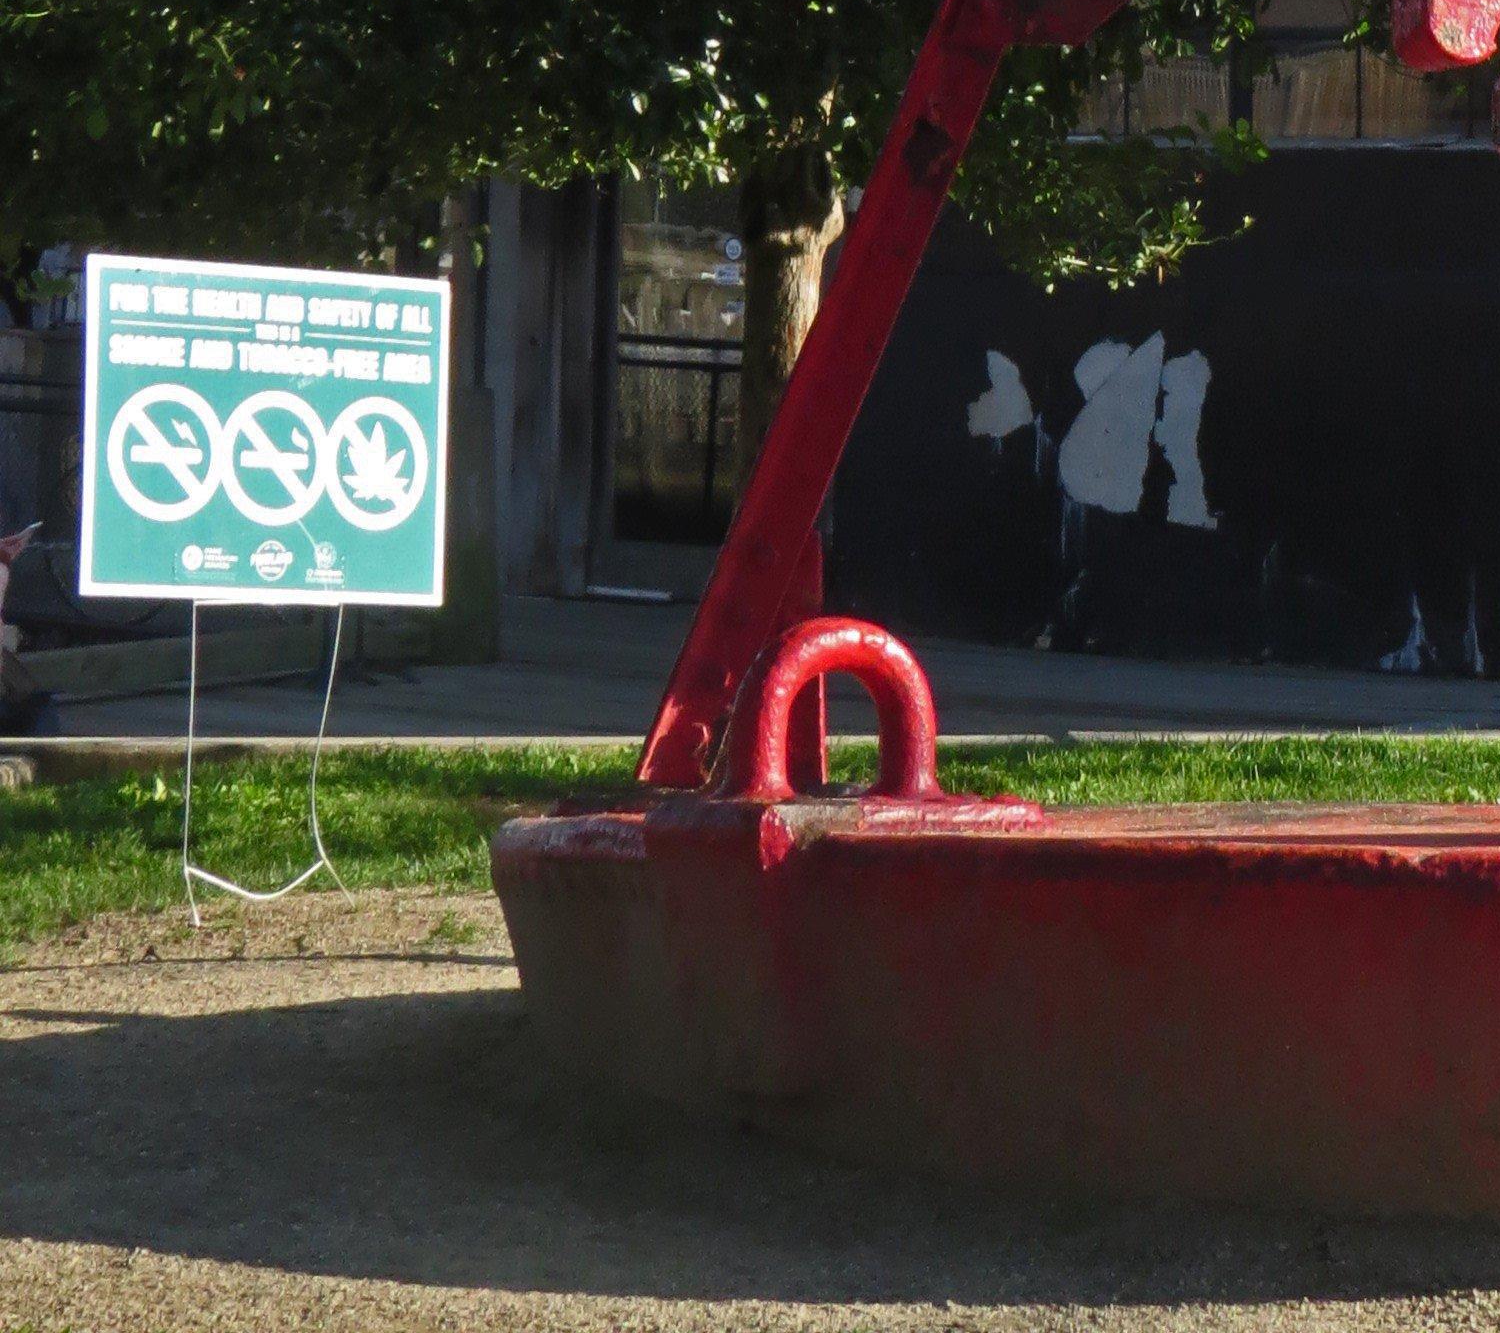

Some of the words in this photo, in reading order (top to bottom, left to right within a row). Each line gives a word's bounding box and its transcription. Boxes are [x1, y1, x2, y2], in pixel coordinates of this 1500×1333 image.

[110, 283, 149, 313] FOR
[151, 285, 189, 315] THE
[192, 289, 262, 320] HEALTH
[266, 294, 304, 323] AND
[308, 298, 372, 328] SAFETY
[376, 303, 398, 330] OF
[402, 305, 433, 333] ALL
[109, 334, 185, 367] SMOKE
[190, 339, 233, 370] AND
[383, 352, 431, 384] AREA
